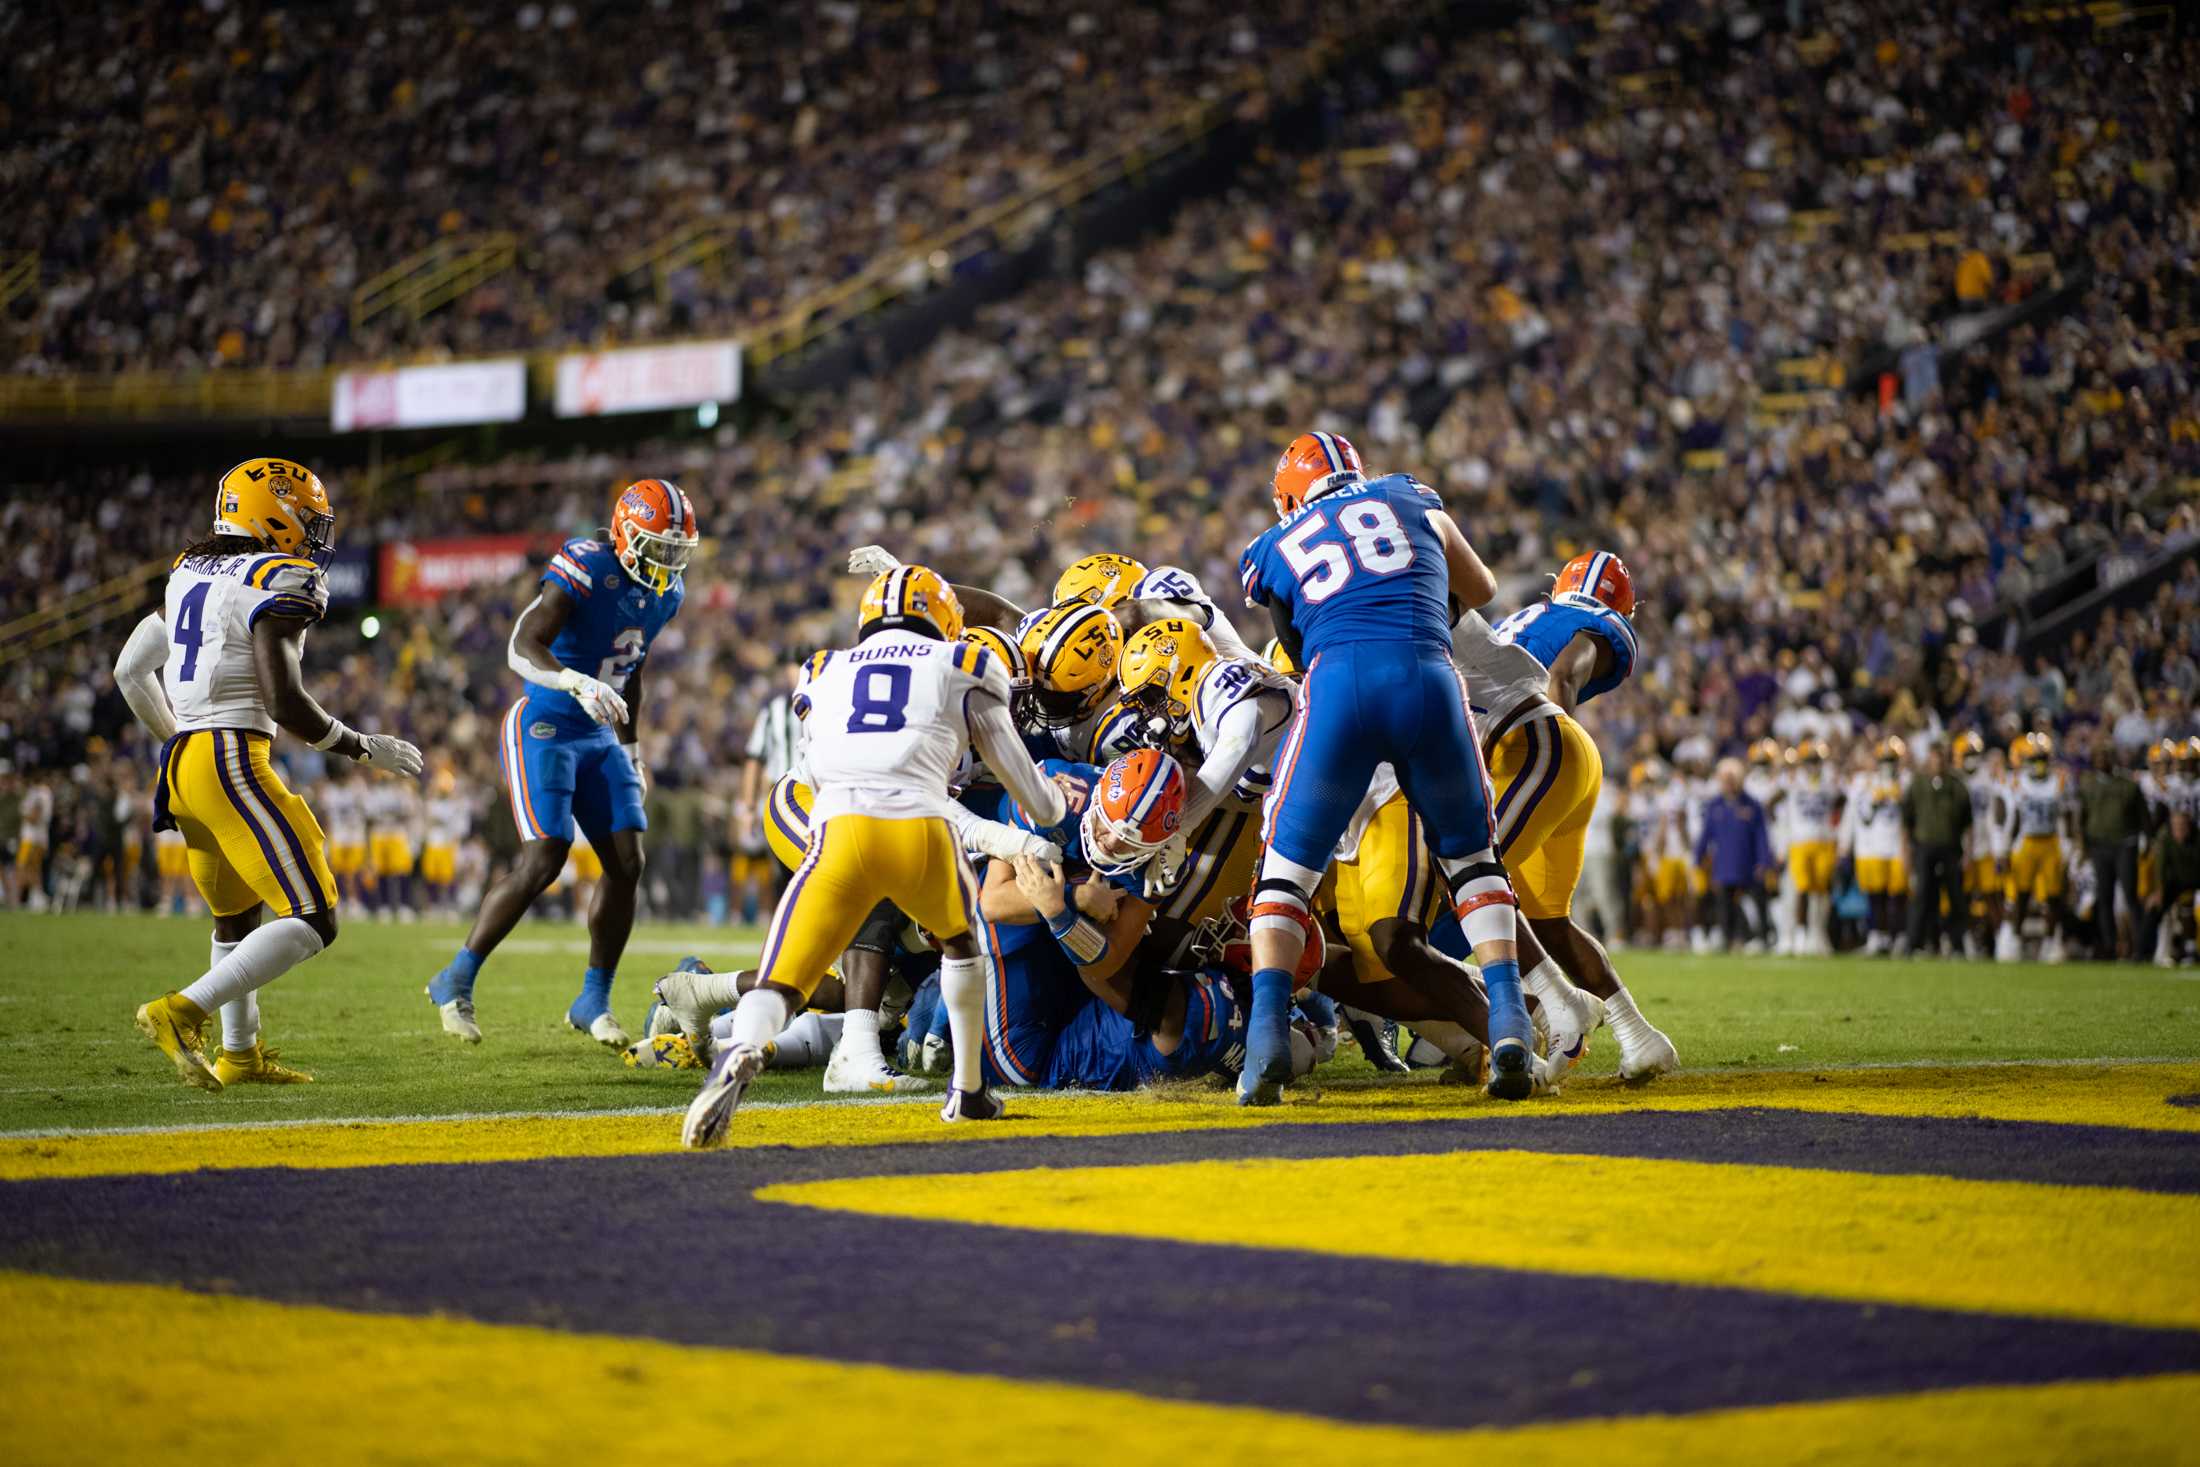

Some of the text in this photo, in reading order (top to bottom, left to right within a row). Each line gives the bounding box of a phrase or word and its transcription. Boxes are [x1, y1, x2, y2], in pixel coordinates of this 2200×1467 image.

[571, 539, 600, 557] 2
[1275, 499, 1416, 604] 58
[301, 575, 316, 597] 4
[1150, 571, 1195, 599] 35
[174, 582, 212, 682] 4
[597, 626, 645, 692] 2
[848, 644, 934, 664] BURNS
[846, 663, 912, 734] 8
[1213, 663, 1252, 700] 30
